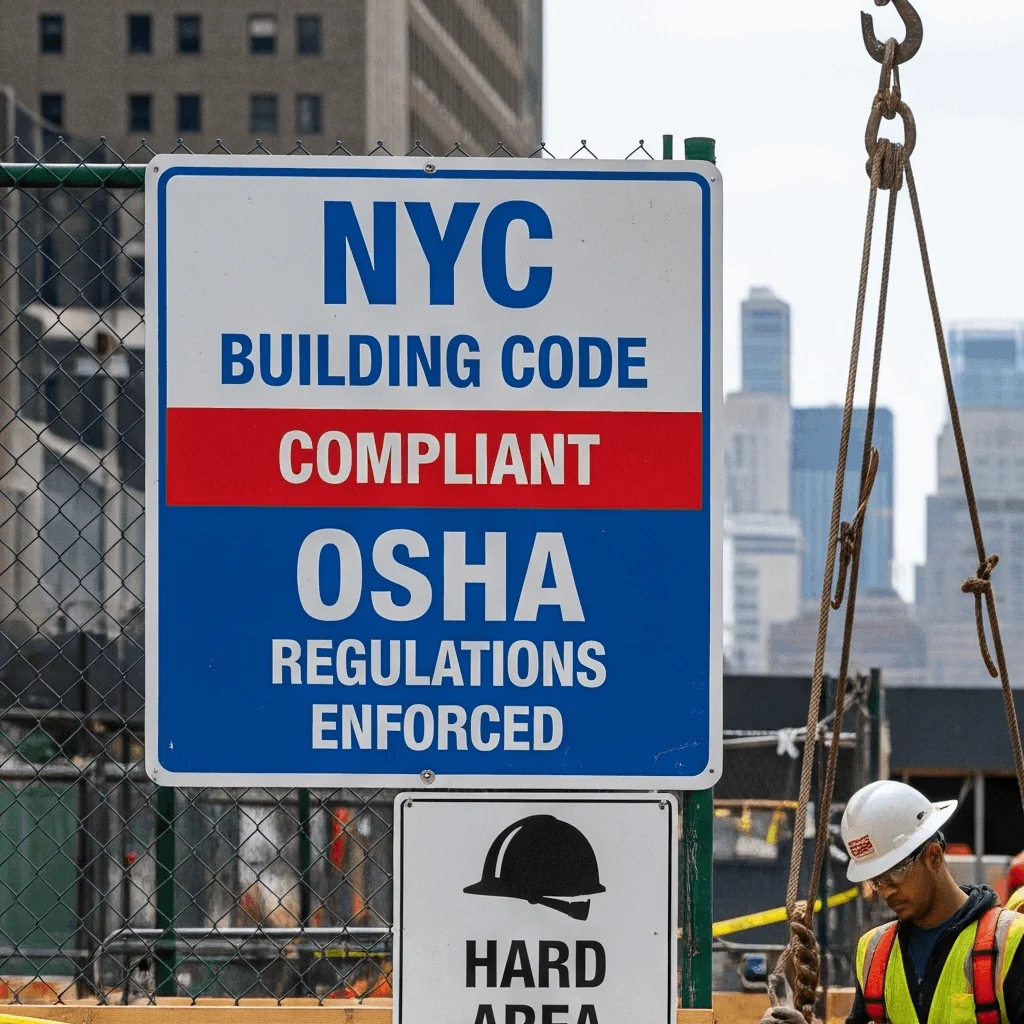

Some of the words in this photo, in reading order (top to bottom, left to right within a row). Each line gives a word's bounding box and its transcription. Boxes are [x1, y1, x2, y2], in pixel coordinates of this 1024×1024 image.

[324, 200, 552, 308] NYC
[221, 333, 480, 388] BUILDING
[501, 335, 647, 389] CODE
[279, 430, 600, 485] COMPLIANT
[297, 529, 584, 621] OSHA
[273, 639, 606, 687] REGULATIONS
[313, 704, 562, 751] ENFORCED
[466, 940, 605, 987] HARD
